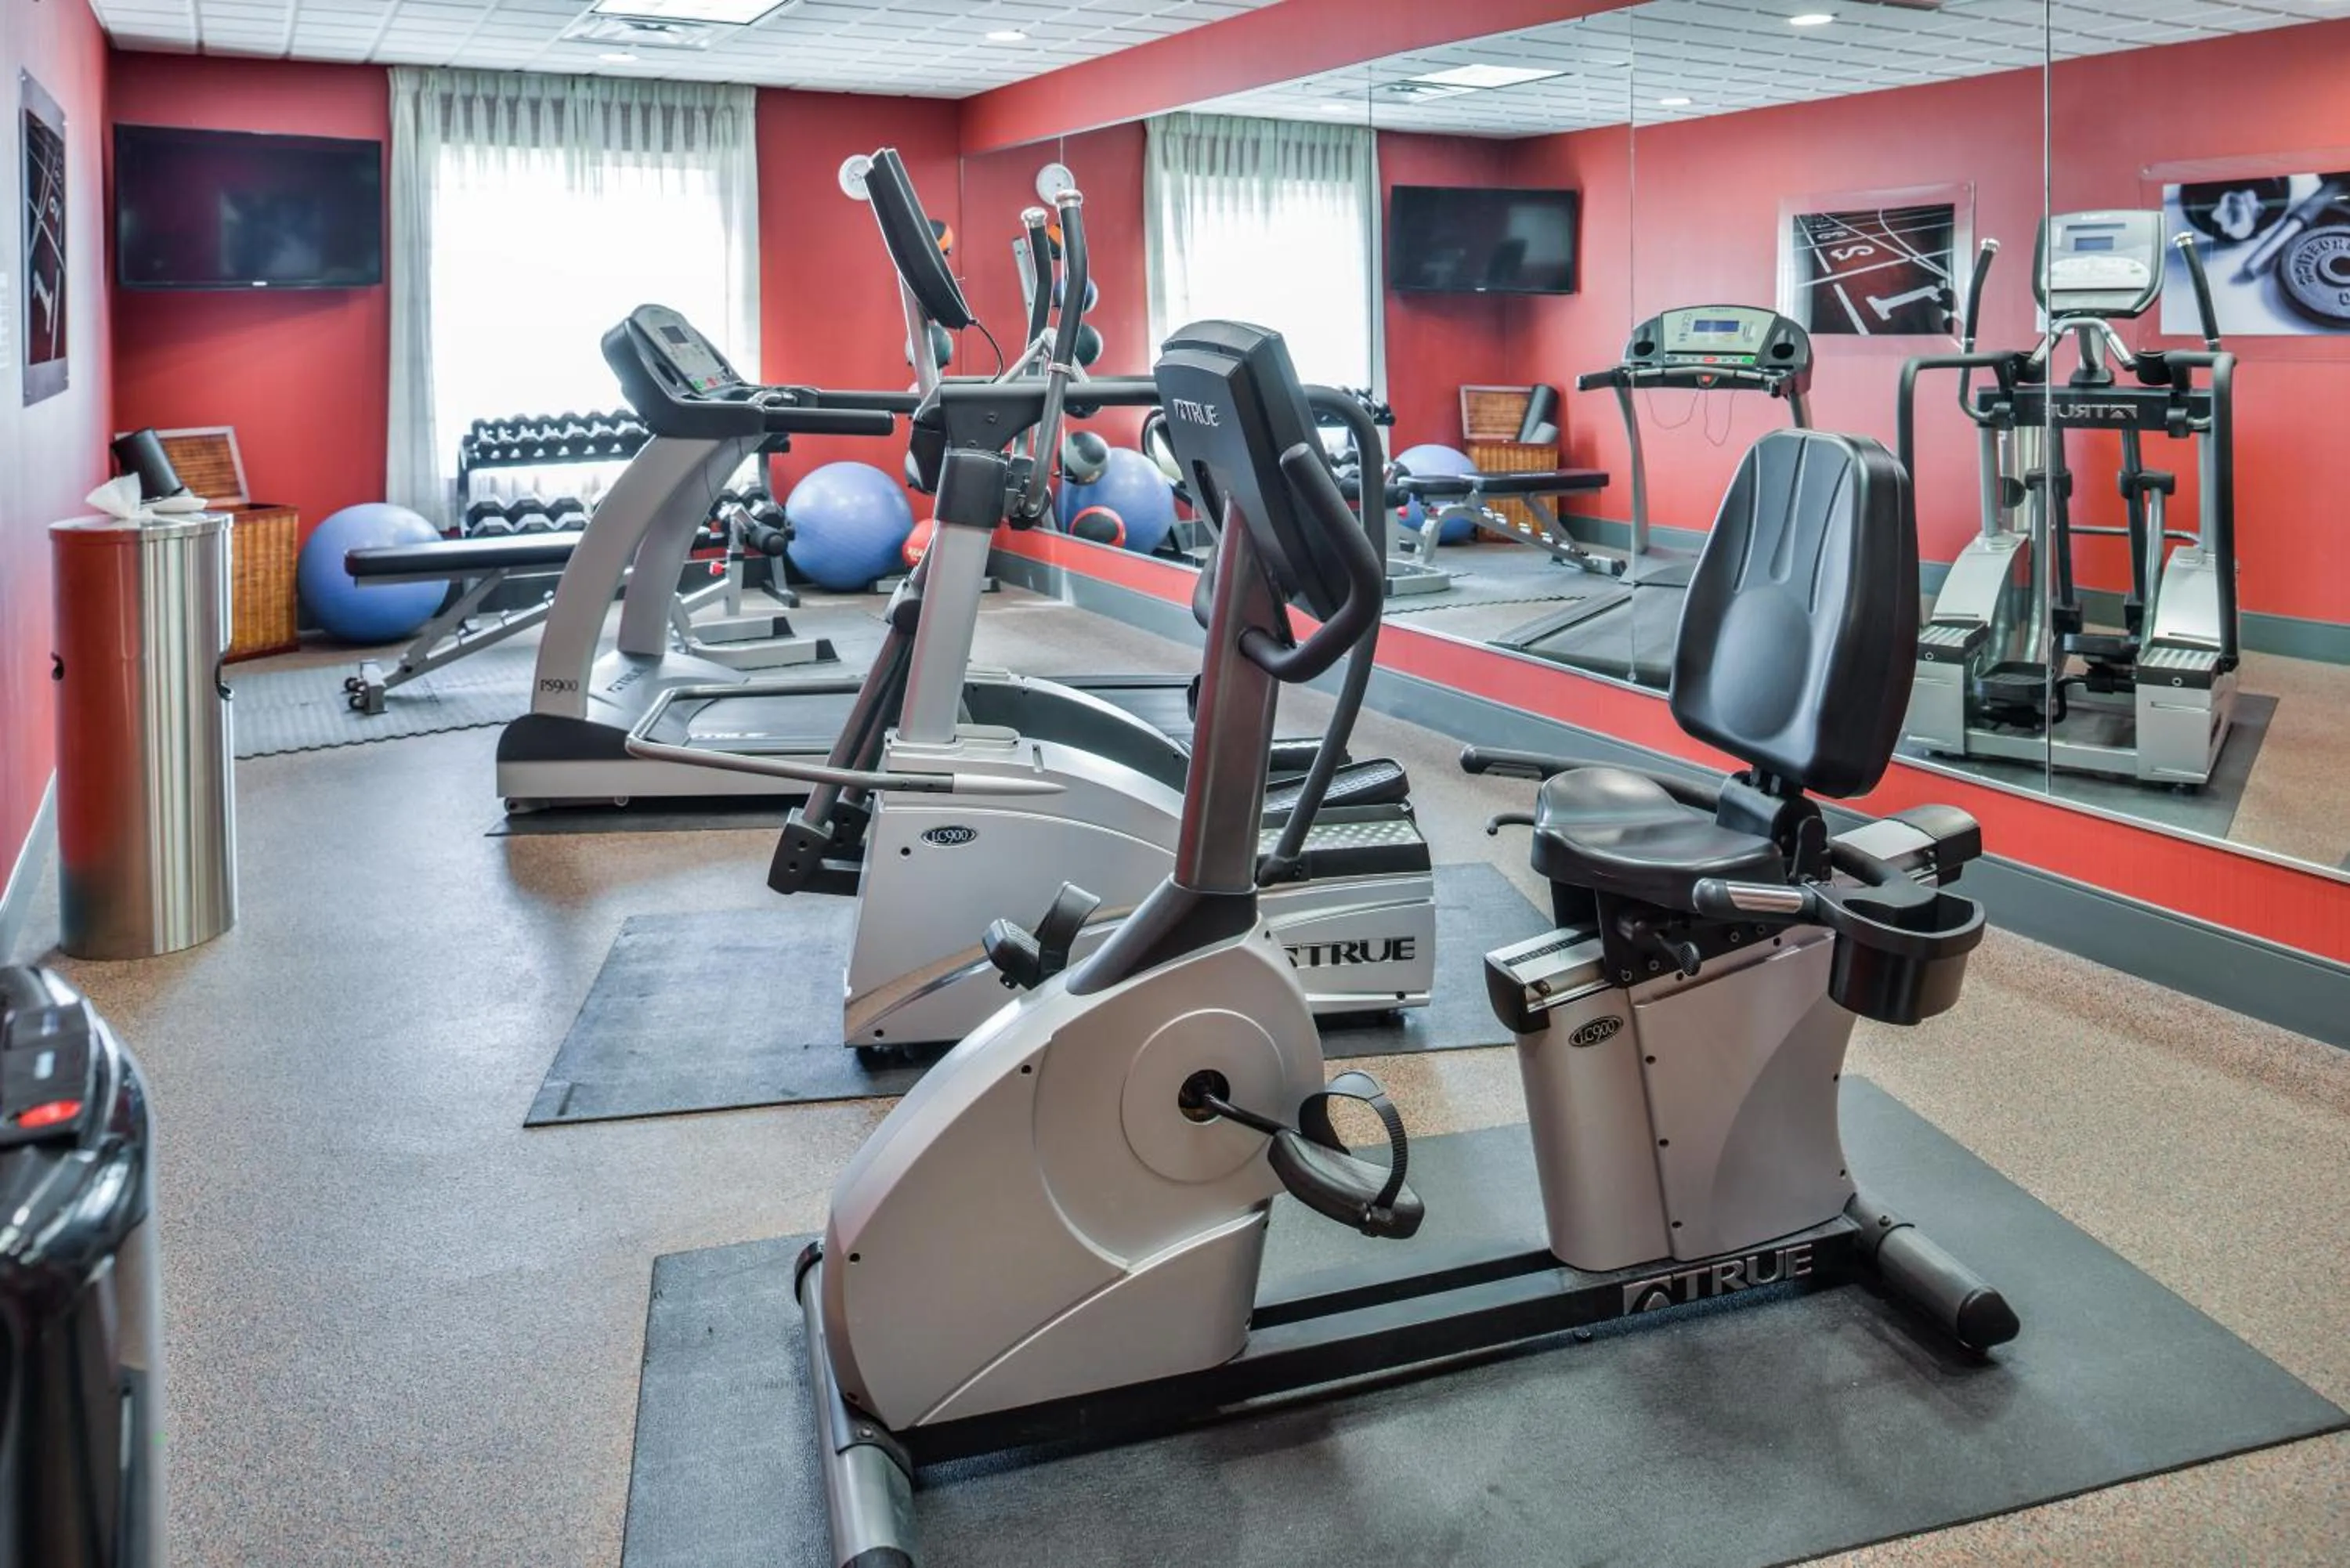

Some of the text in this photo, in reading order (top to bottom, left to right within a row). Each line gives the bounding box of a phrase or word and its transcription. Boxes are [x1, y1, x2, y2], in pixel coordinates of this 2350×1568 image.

[1182, 400, 1220, 427] TRUE
[540, 679, 579, 694] PS900
[1300, 937, 1415, 967] TRUE
[1672, 1244, 1813, 1301] TRUE
